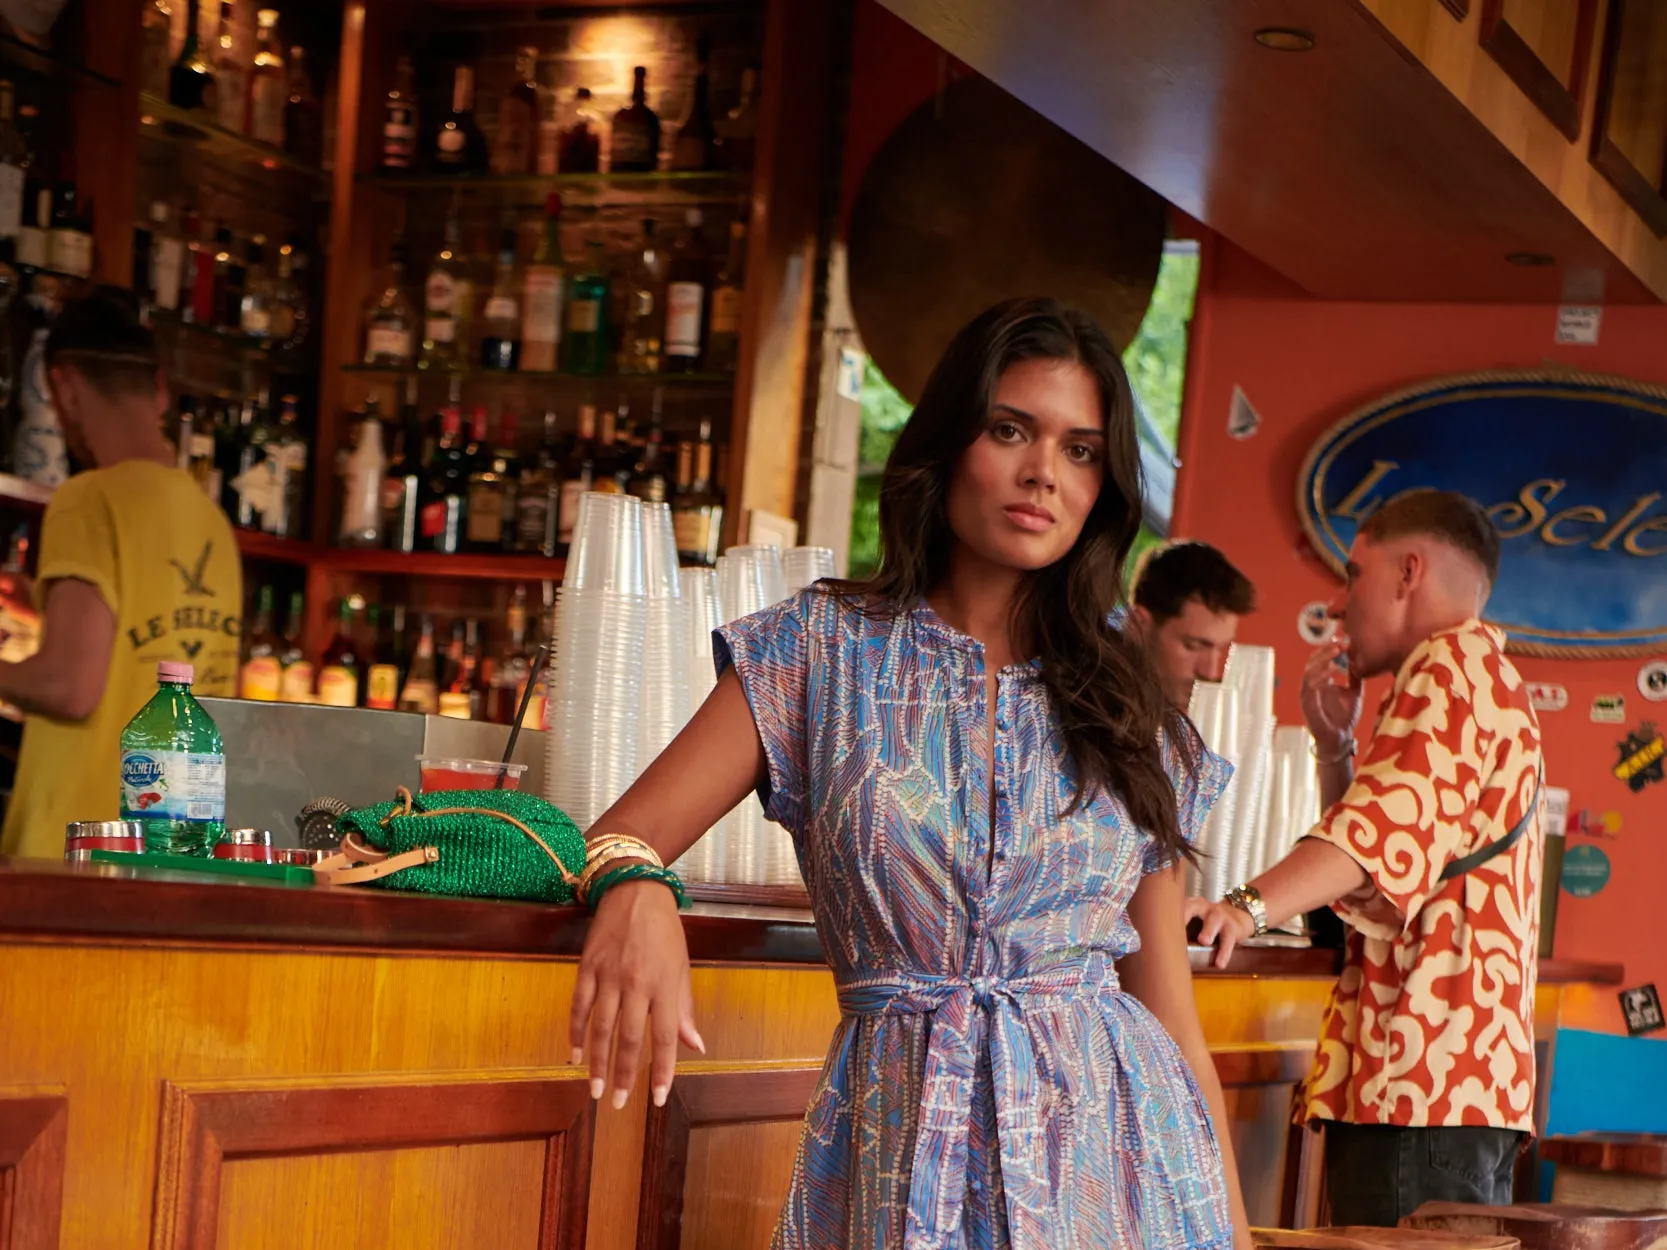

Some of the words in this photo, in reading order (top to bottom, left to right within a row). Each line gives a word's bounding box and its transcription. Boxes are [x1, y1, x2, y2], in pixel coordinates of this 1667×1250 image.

[1487, 480, 1667, 557] Sele
[128, 615, 166, 649] LE
[173, 606, 241, 637] SELEC
[123, 762, 164, 776] OCCHETTA
